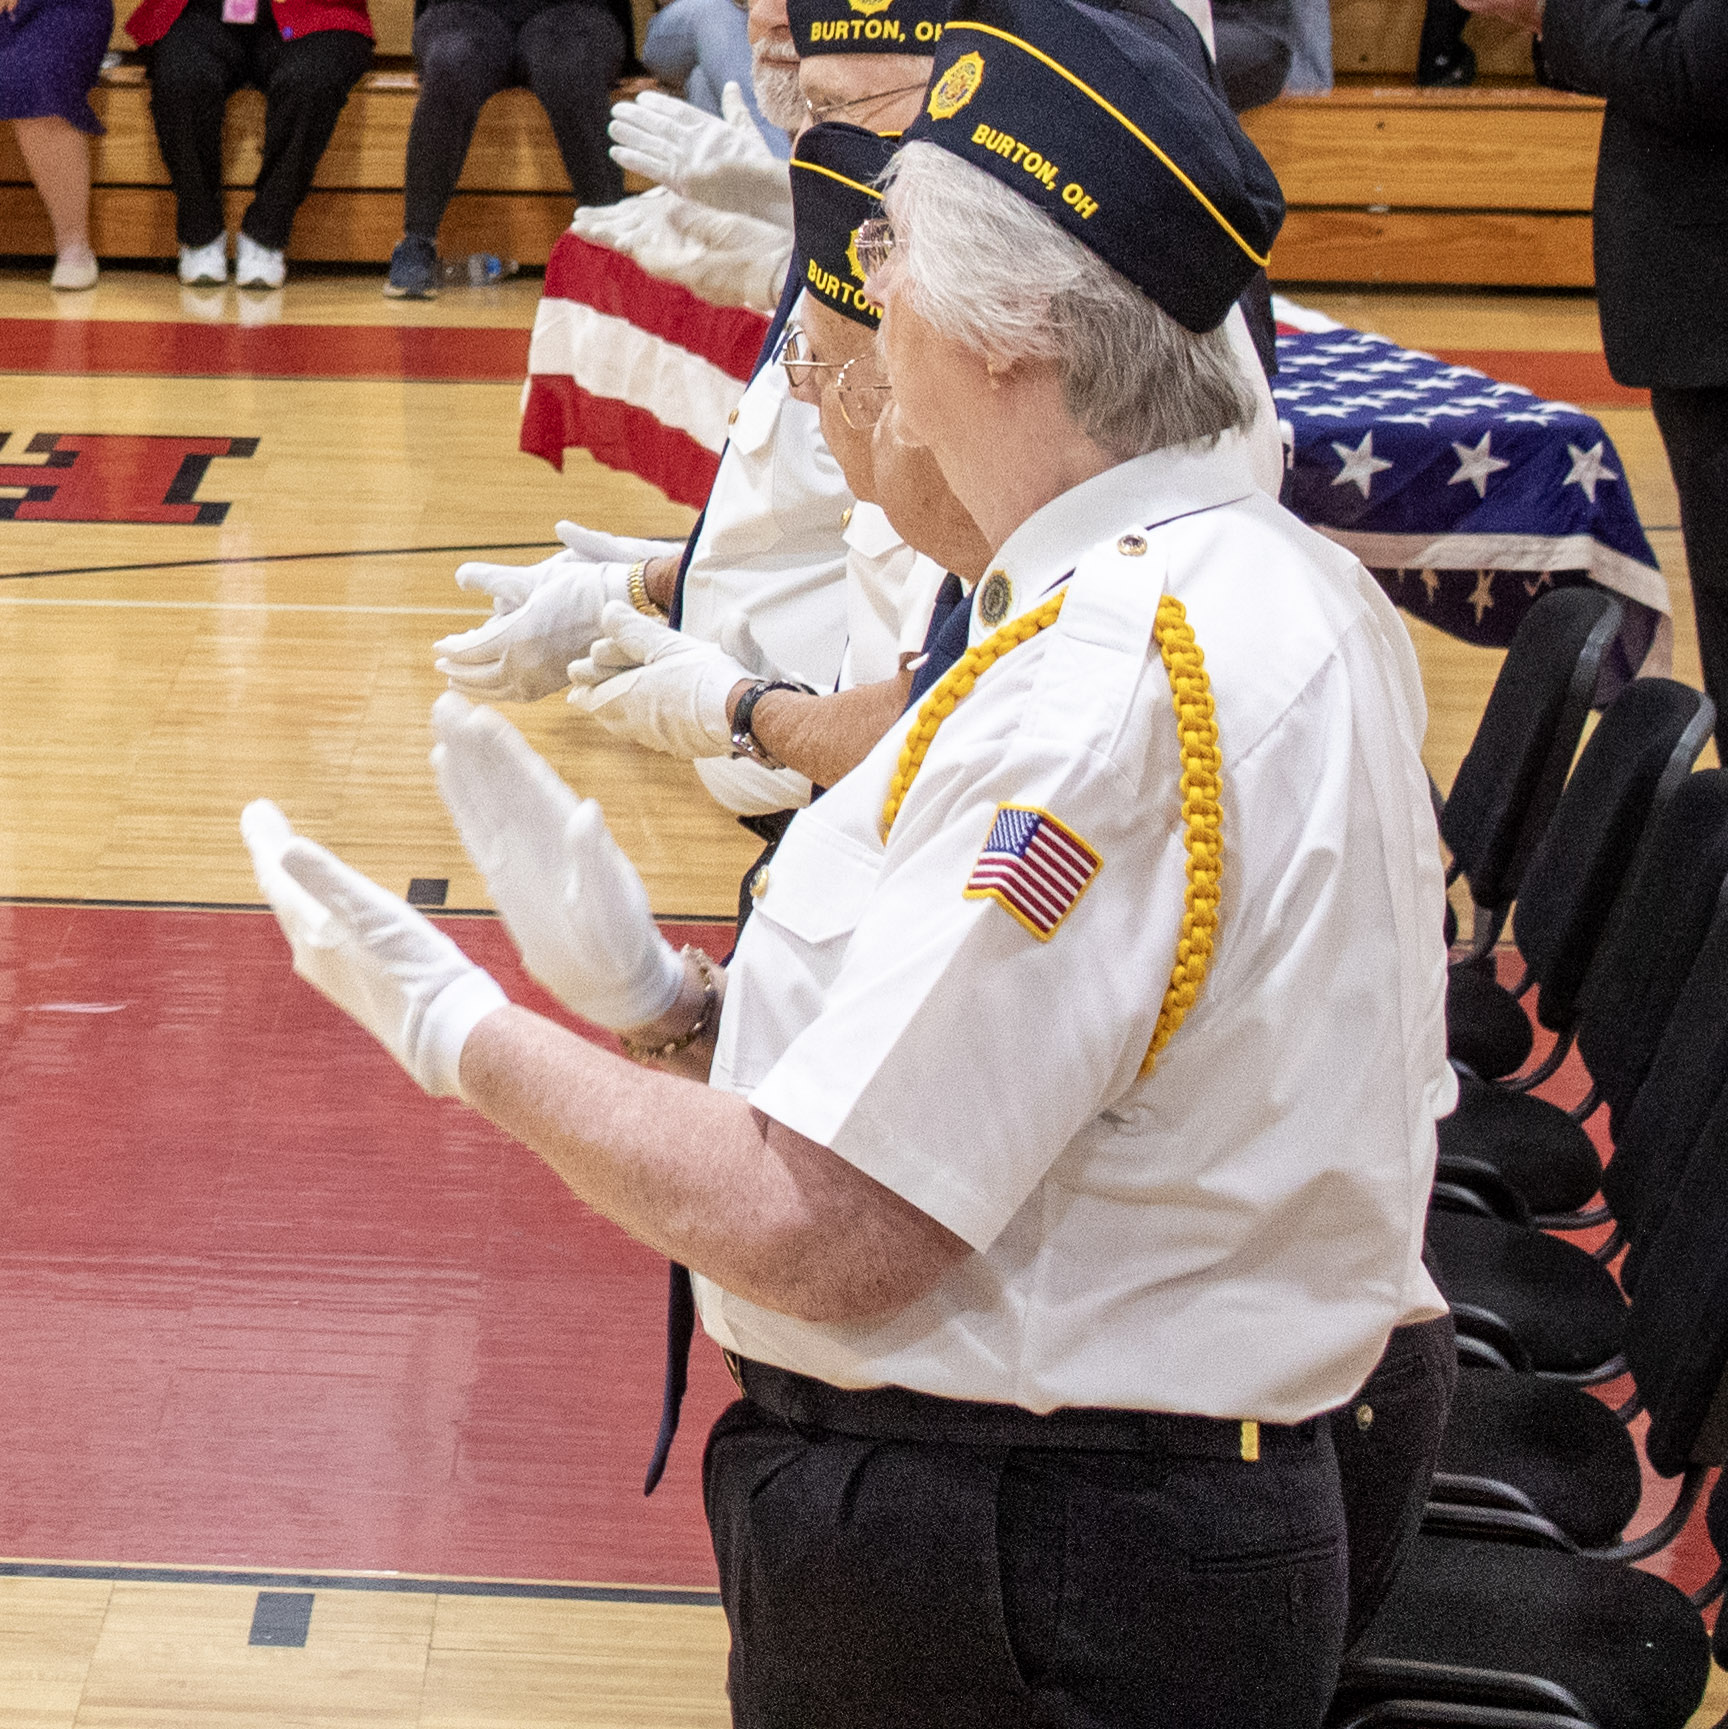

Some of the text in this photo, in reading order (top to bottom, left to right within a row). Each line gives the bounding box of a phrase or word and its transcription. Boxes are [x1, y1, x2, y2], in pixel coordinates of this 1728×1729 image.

[810, 18, 907, 43] BURTON,
[971, 123, 1100, 220] BURTON, OH
